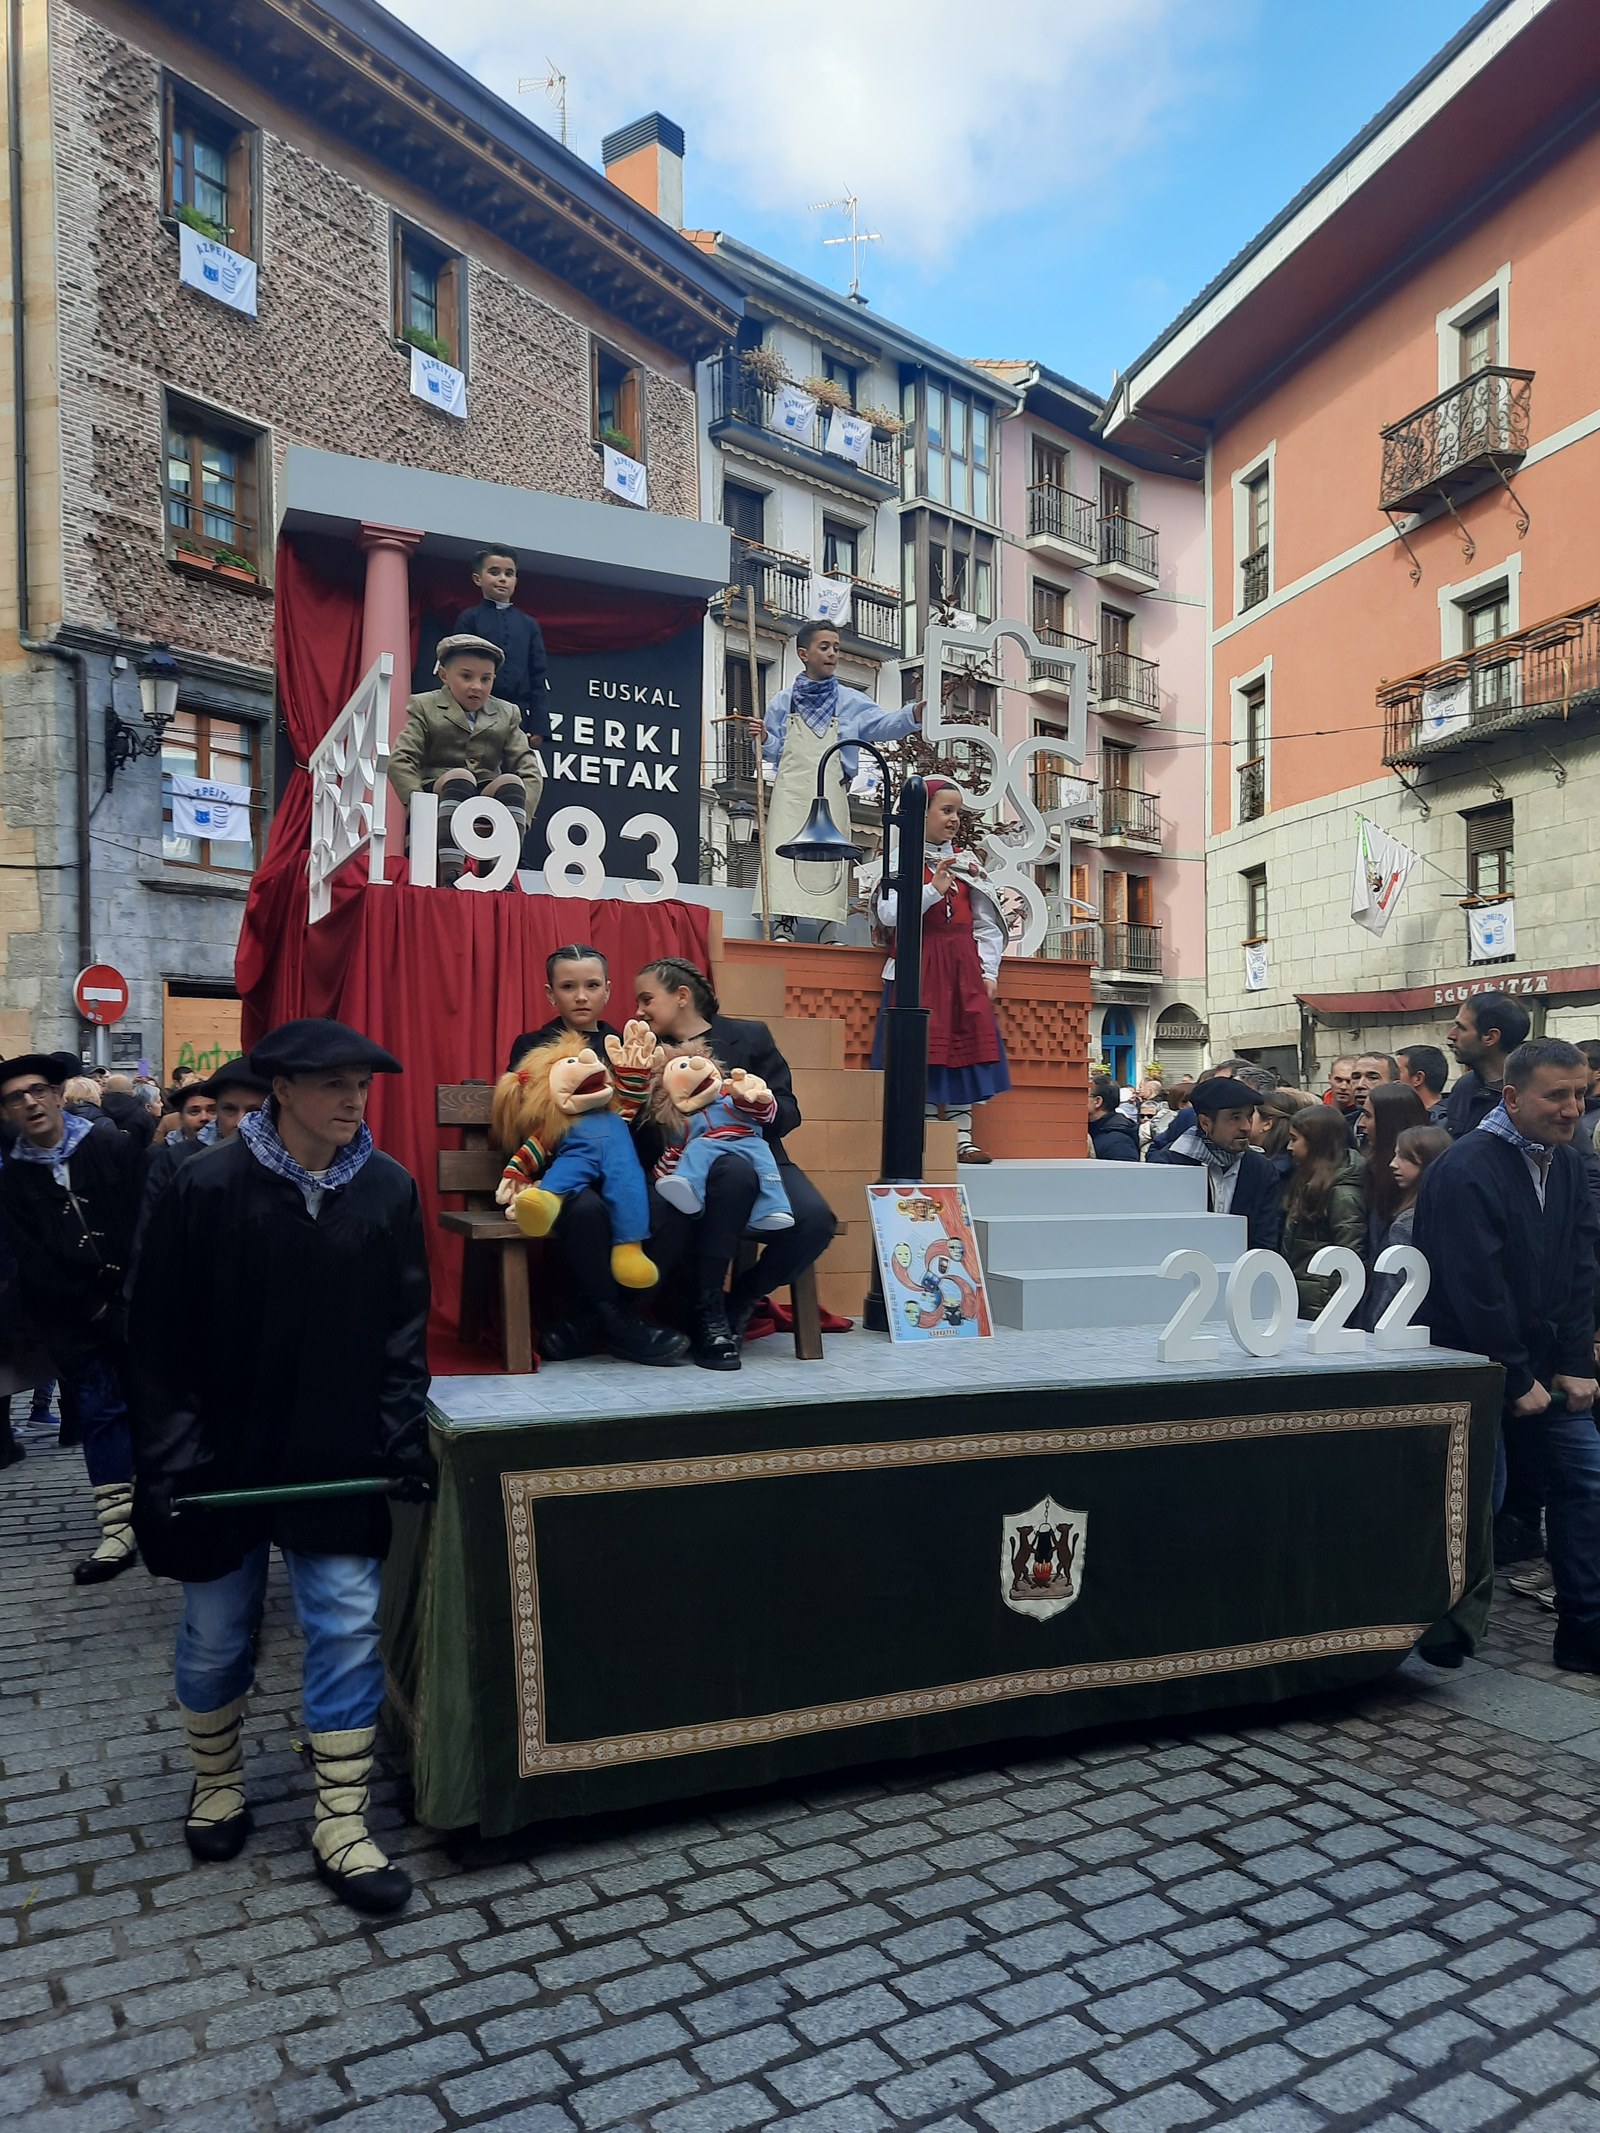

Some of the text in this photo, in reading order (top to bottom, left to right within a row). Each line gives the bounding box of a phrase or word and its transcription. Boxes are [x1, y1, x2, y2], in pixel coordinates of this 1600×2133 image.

[196, 242, 242, 275] AZPEITIA
[421, 360, 456, 386] AZPEITIA
[588, 679, 681, 709] EUSKAL
[548, 712, 681, 756] ZERKI
[534, 749, 680, 793] AKETAK
[187, 786, 234, 805] ZPEITI
[409, 790, 680, 904] 1983
[1156, 1244, 1431, 1363] 2022
